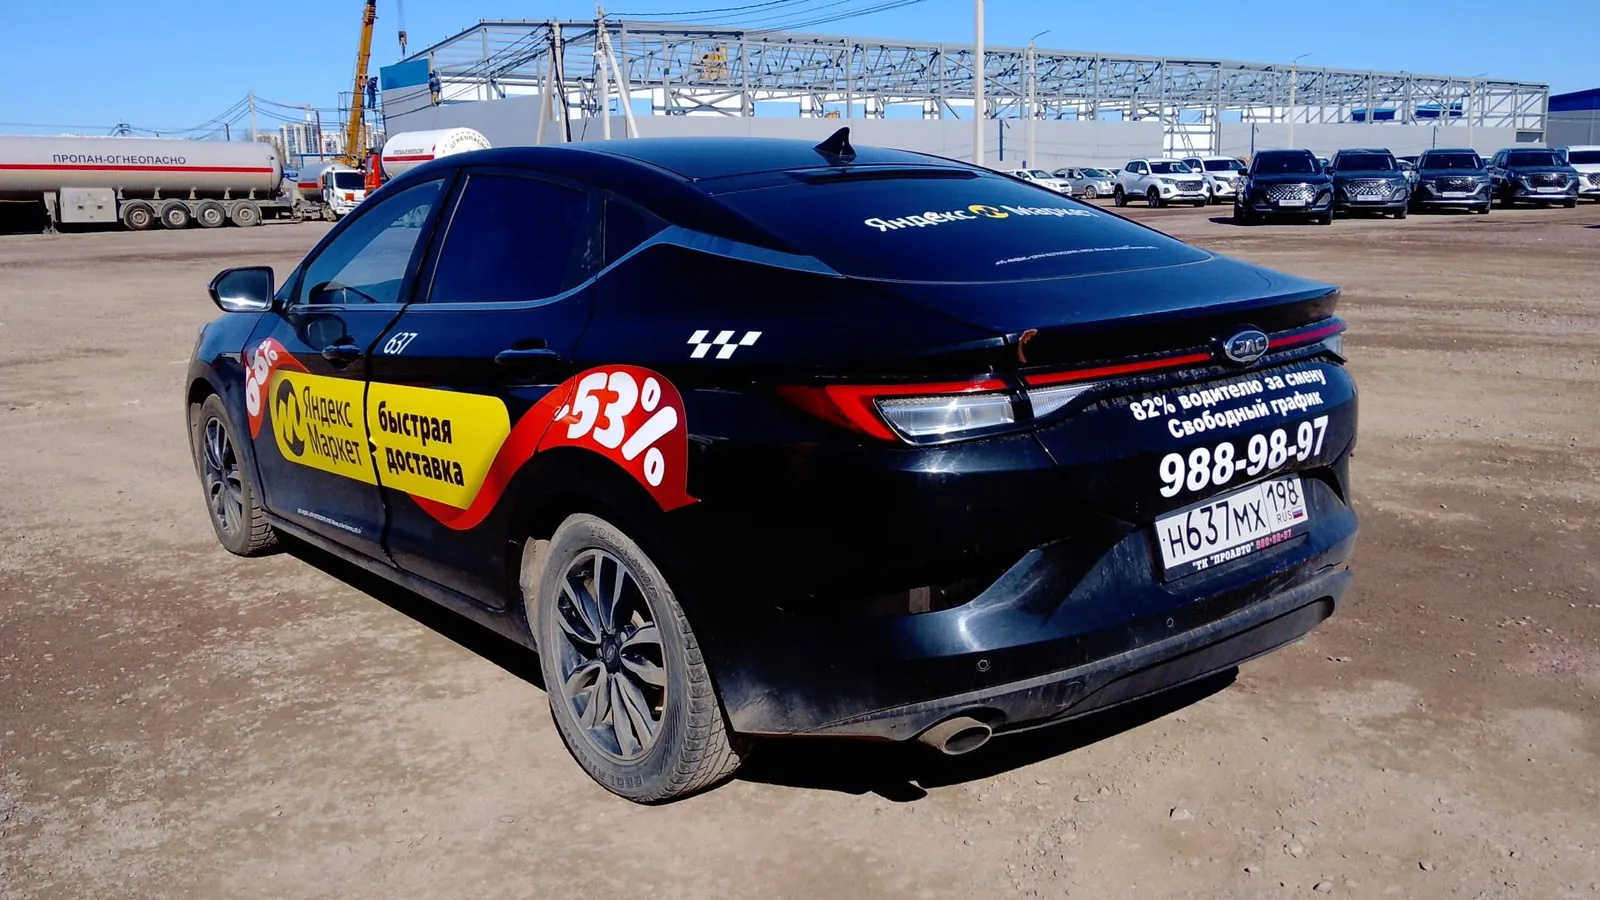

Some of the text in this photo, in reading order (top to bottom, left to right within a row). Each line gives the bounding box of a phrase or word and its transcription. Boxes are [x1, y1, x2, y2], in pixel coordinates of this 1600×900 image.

[52, 154, 187, 165] ПРОПАН-ОГНЕОПАСНО
[864, 211, 977, 232] Яндекс
[383, 332, 418, 355] 637
[302, 385, 354, 428] Яндекс
[1129, 368, 1327, 421] 82% водителю за смену
[1167, 389, 1324, 439] Свободный график
[306, 422, 363, 466] Маркет
[377, 401, 453, 446] быстрая
[385, 447, 465, 487] доставка
[1159, 415, 1329, 498] 988-98-97
[1266, 478, 1300, 512] 198
[1277, 510, 1293, 524] RUS
